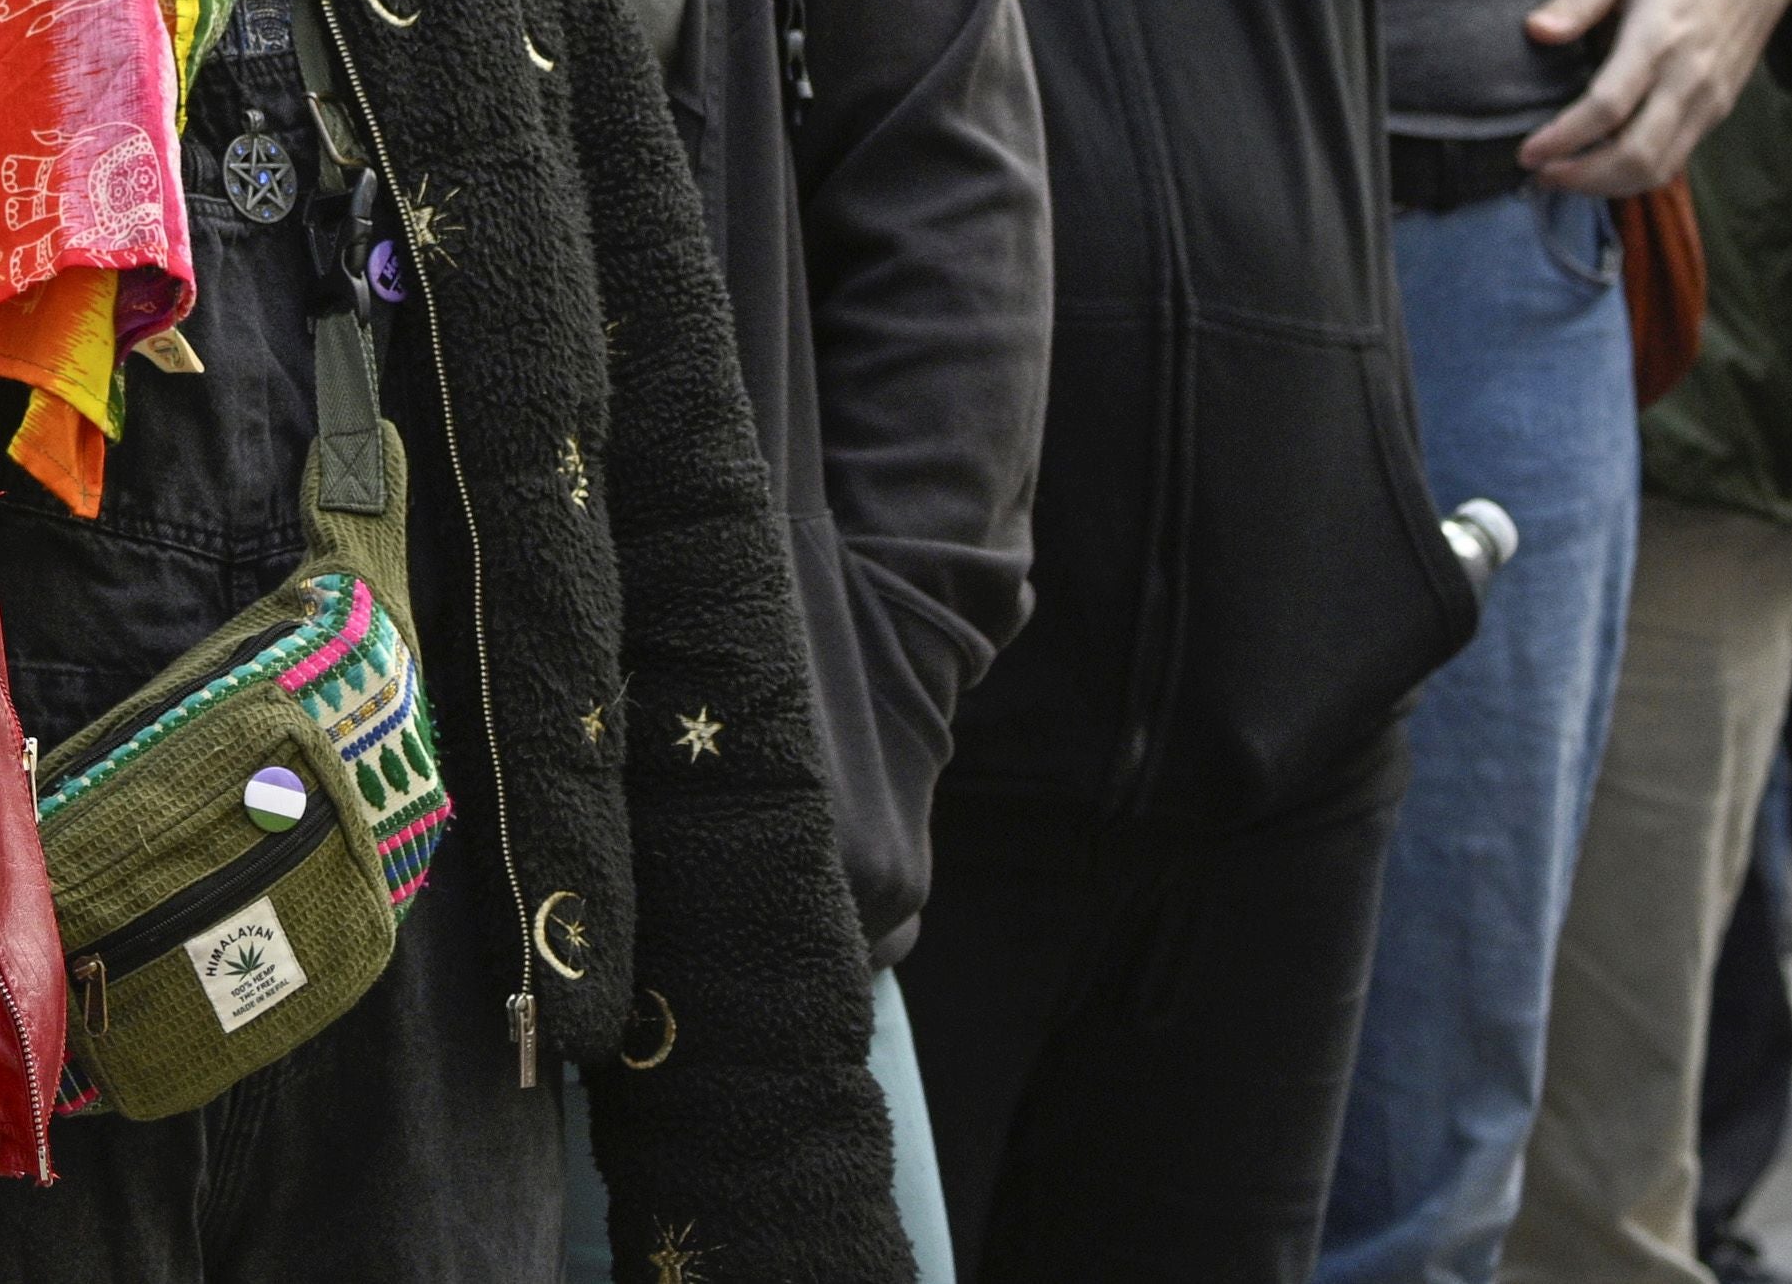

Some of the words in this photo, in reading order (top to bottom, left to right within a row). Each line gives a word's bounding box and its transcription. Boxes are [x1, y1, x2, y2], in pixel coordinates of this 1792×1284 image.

[205, 925, 274, 977] HIMALAYAN
[230, 981, 252, 997] 100%
[253, 964, 276, 983] HEMP
[232, 1001, 255, 1017] MADE
[256, 994, 264, 1004] IN
[265, 978, 290, 998] NEPAL
[239, 989, 255, 1002] THC
[256, 976, 276, 992] FREE
